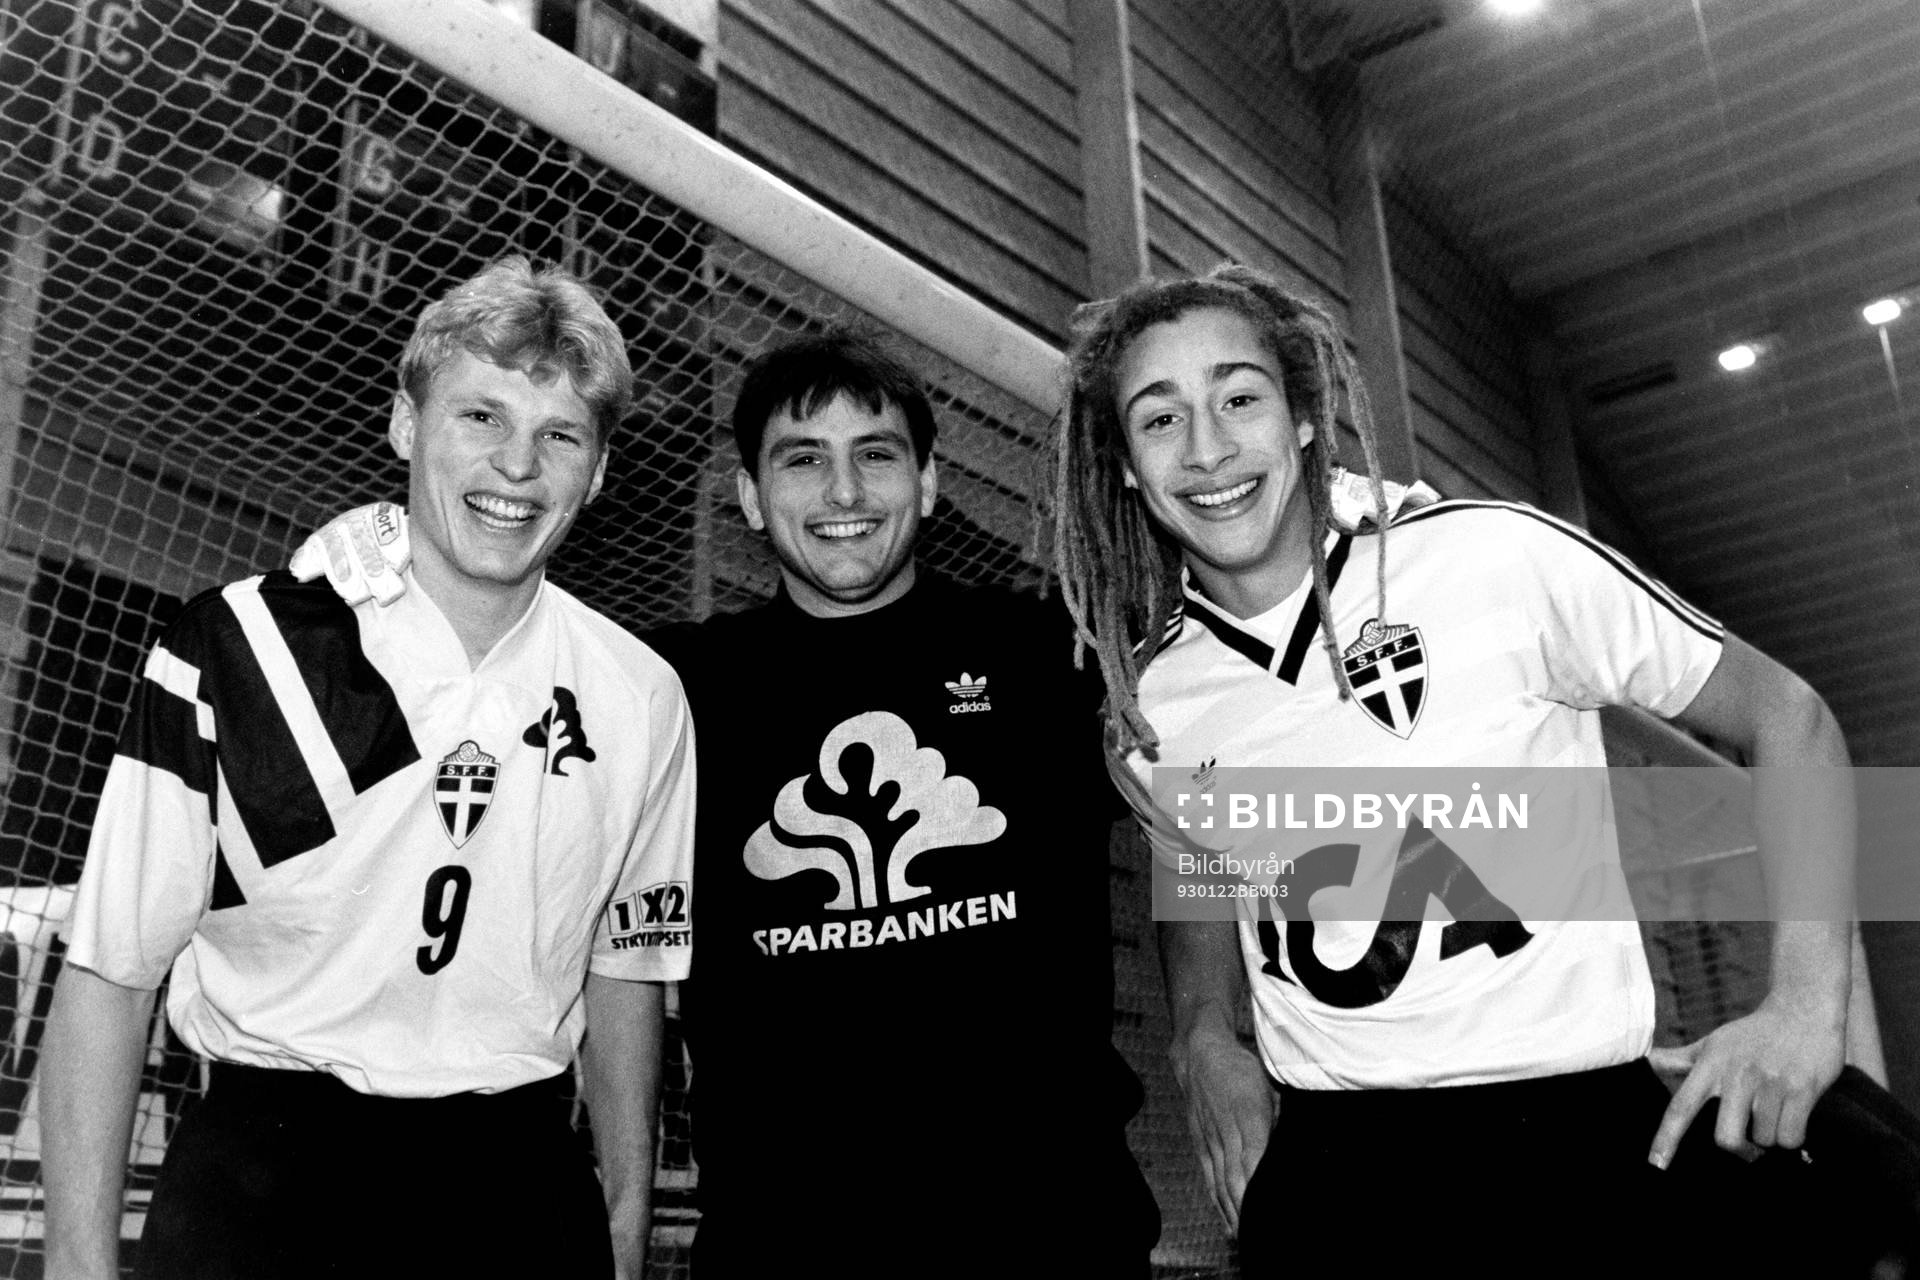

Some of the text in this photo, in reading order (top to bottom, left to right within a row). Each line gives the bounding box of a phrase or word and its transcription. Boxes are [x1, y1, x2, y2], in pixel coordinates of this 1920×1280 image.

[949, 701, 991, 713] adidas
[416, 864, 471, 975] 9
[611, 930, 690, 949] STRYPSET
